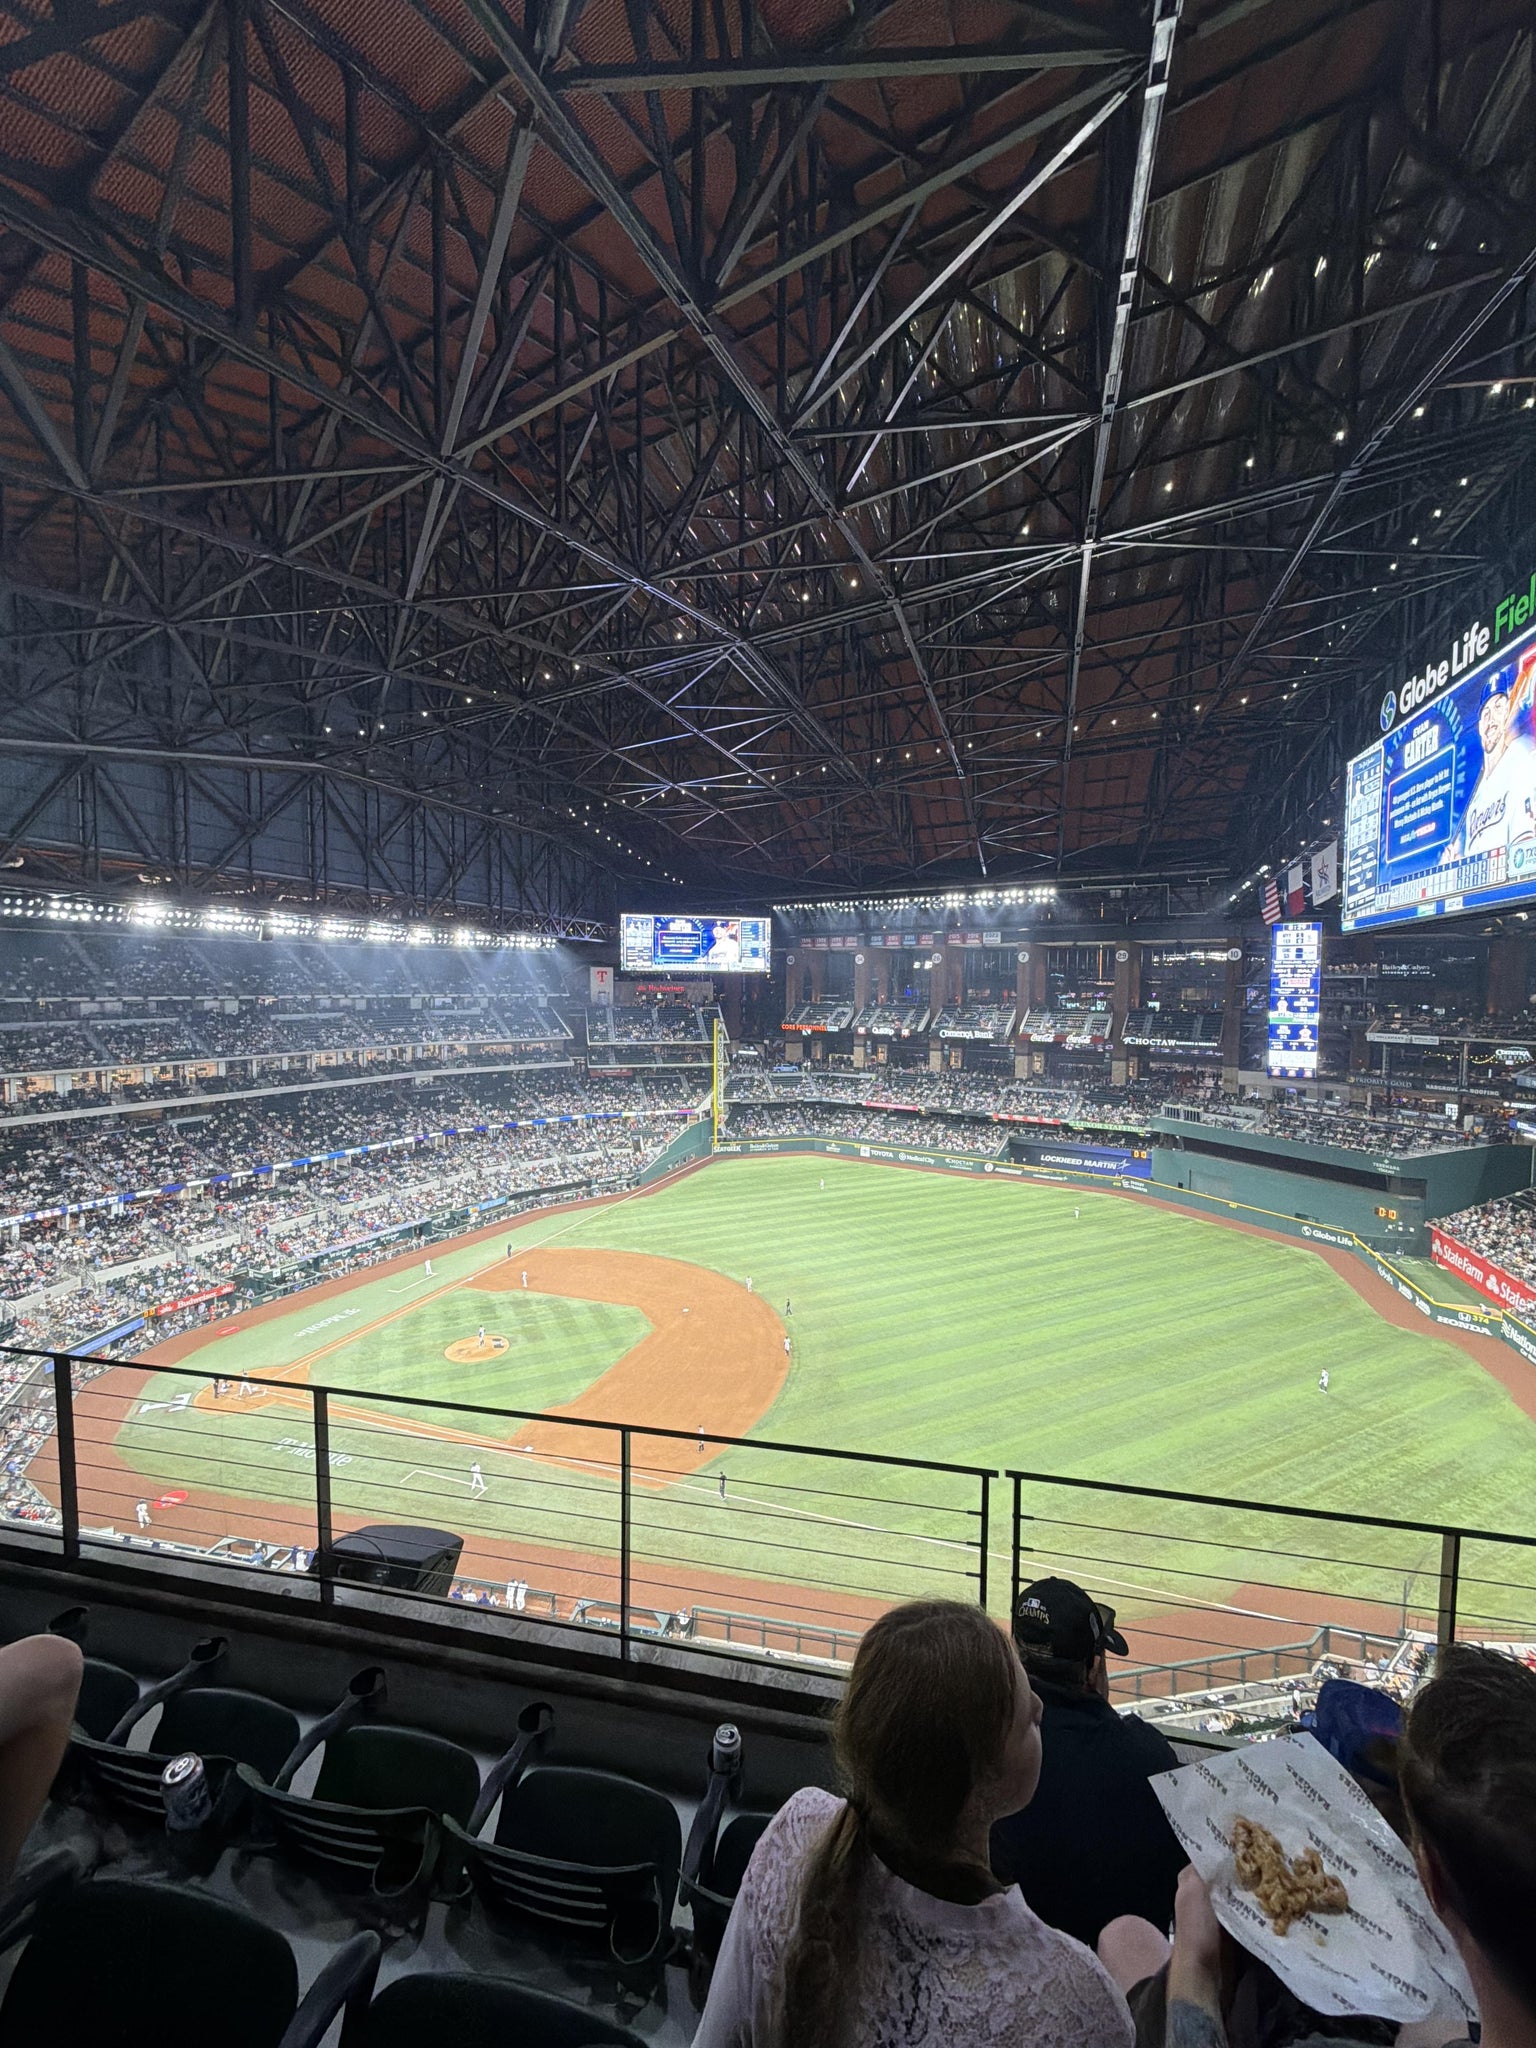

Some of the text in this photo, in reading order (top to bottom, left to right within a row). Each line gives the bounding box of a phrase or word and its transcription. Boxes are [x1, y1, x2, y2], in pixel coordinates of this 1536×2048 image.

[1400, 572, 1536, 714] Globe Life Fiel
[1230, 951, 1238, 959] 10
[597, 970, 607, 983] T
[975, 1031, 994, 1039] Bank
[1129, 1037, 1176, 1046] CHOCTAW
[1355, 1076, 1413, 1088] PRIORITY GOLD
[1426, 1084, 1500, 1097] HARGROVE ROOFING
[713, 1145, 741, 1153] SEATGEEK
[870, 1149, 894, 1158] TOYOTA
[1041, 1154, 1117, 1170] LOCKHEED MARTIN
[1312, 1229, 1353, 1247] Globe Life
[177, 1292, 217, 1309] Budweiser
[1437, 1315, 1493, 1336] HONDA
[1472, 1314, 1489, 1324] 374
[1018, 1606, 1050, 1625] CHAMPS
[1237, 1758, 1279, 1805] RANGERS
[1285, 1762, 1331, 1811] RANGERS
[1307, 1827, 1358, 1878] RANGERS
[1365, 1838, 1418, 1880] RANGERS
[1369, 1961, 1428, 2002] RANGERS
